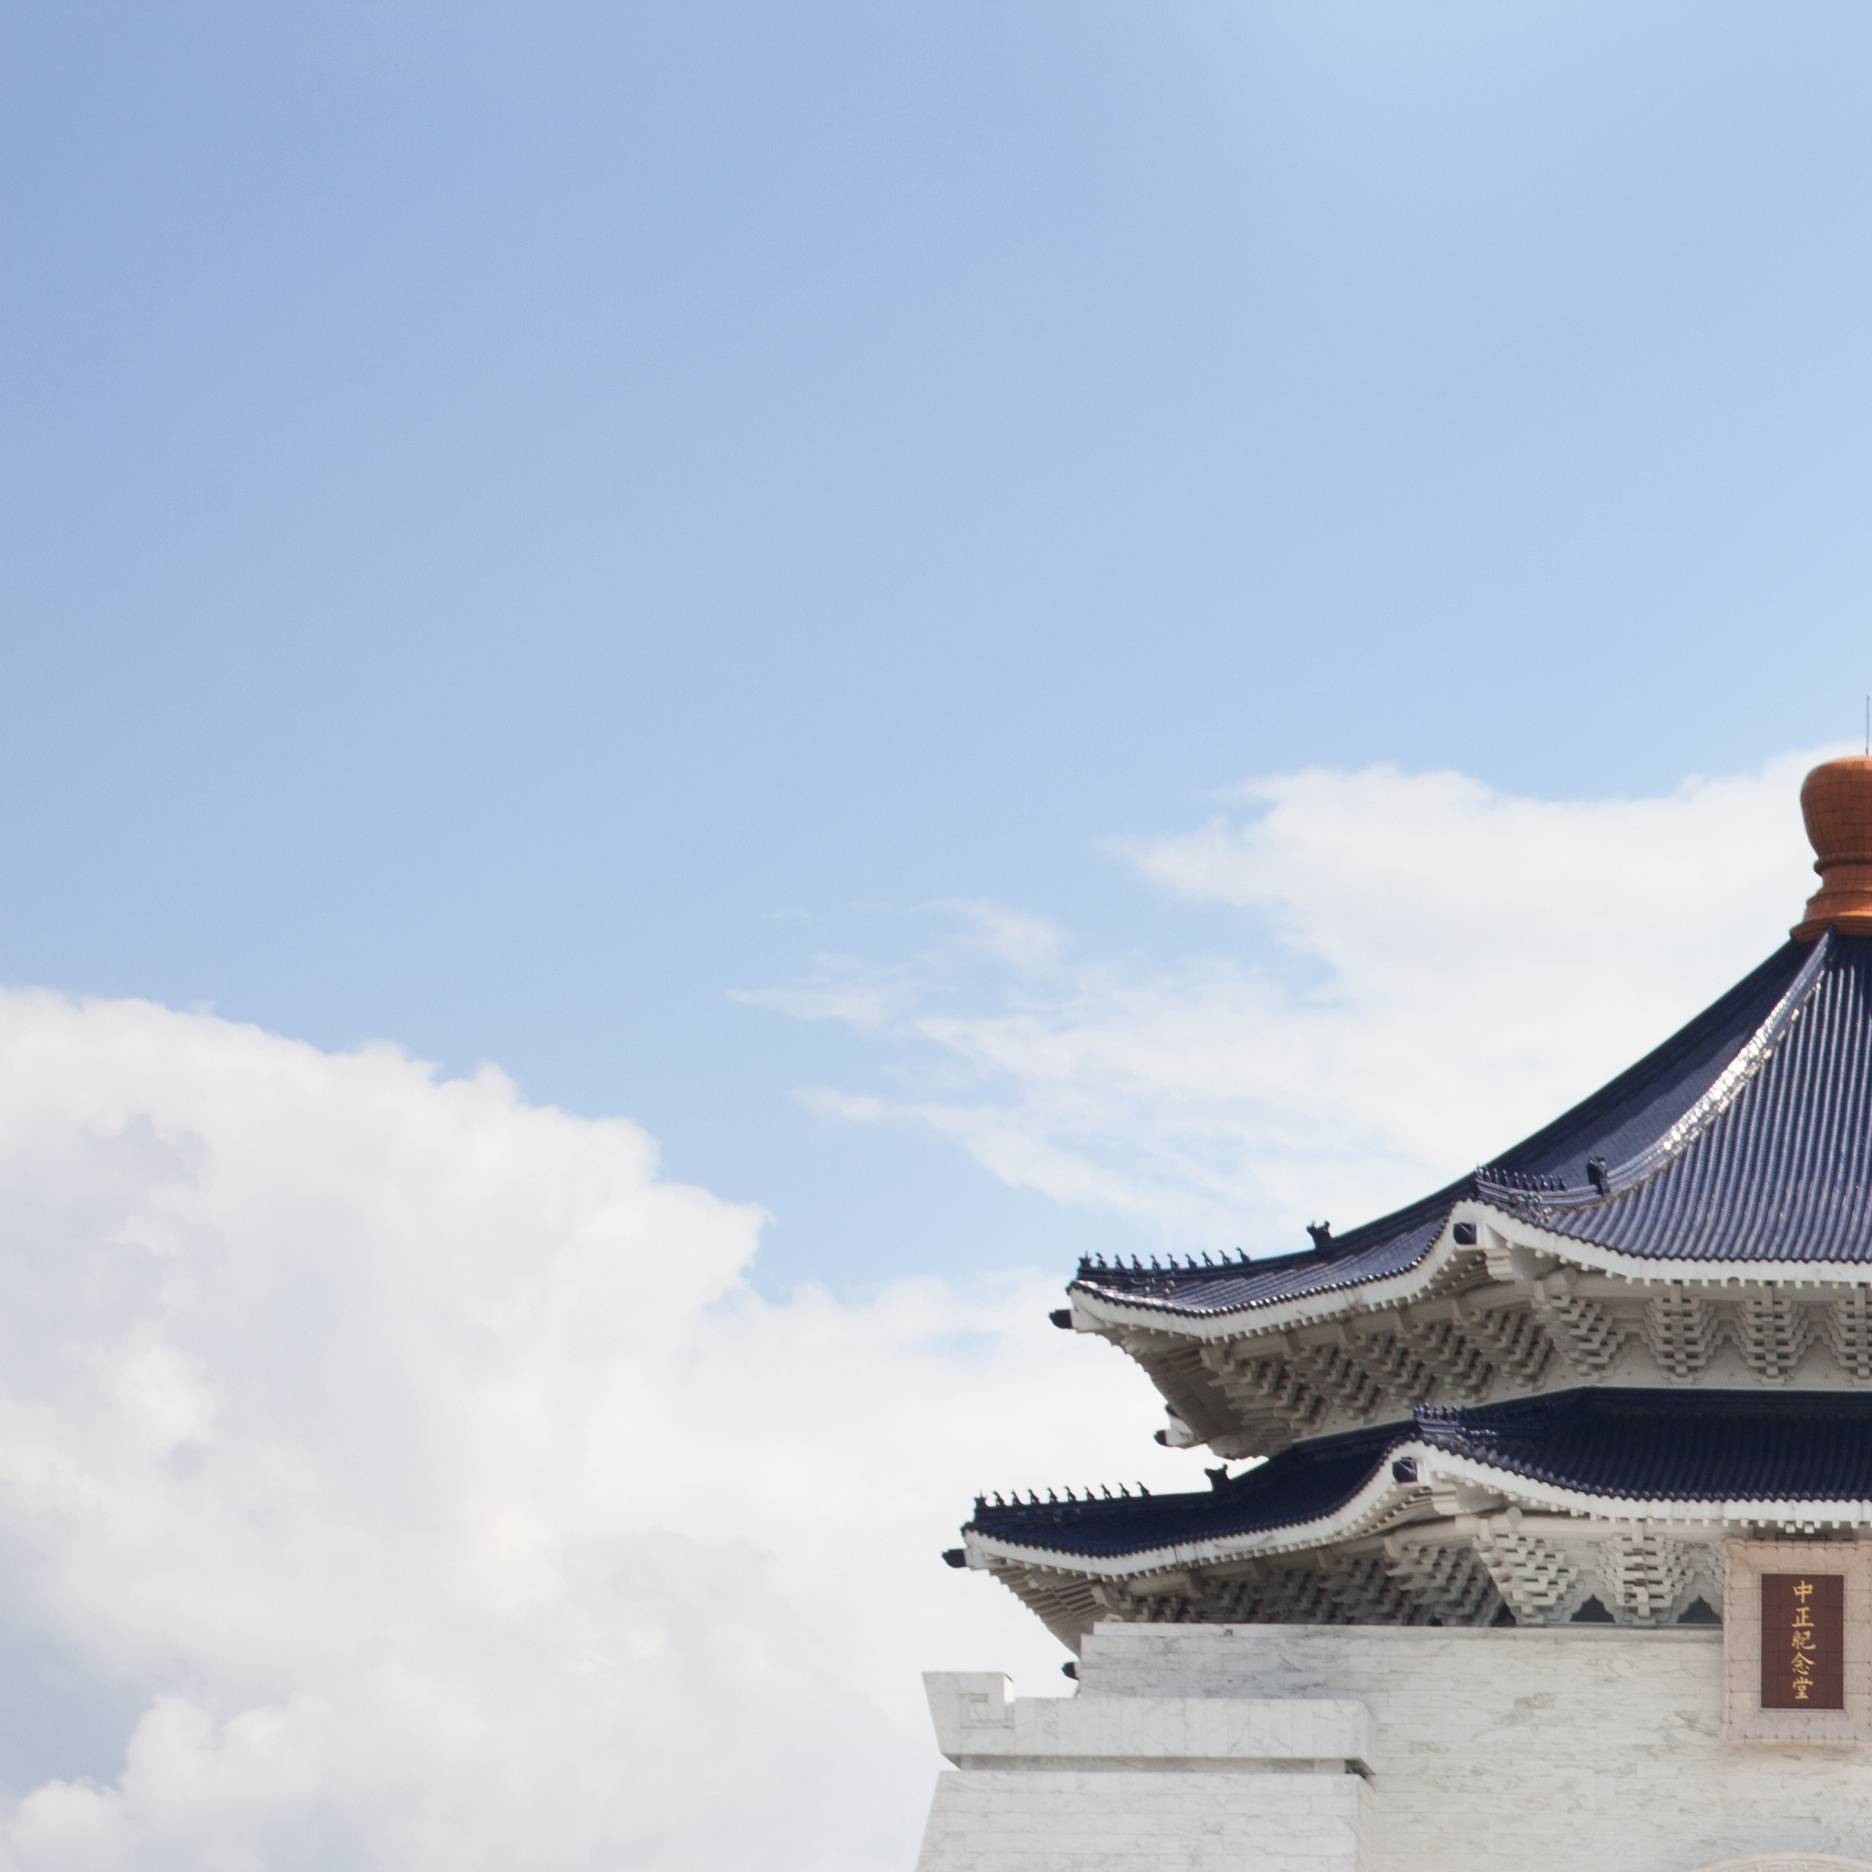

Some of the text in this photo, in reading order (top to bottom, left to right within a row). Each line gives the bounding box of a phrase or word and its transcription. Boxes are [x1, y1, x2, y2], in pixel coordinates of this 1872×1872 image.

[1791, 1580, 1816, 1700] 中正紀念堂
